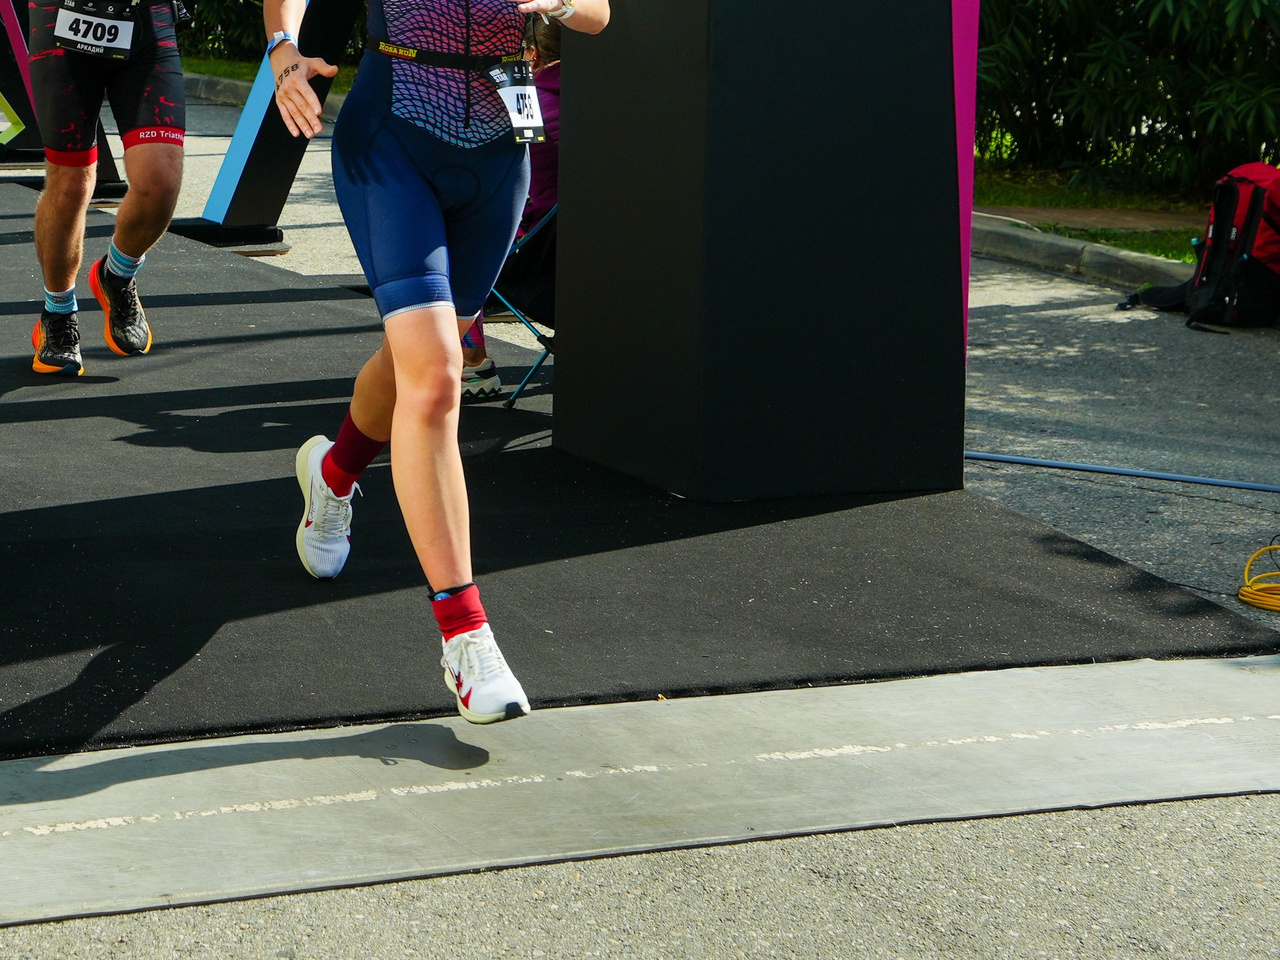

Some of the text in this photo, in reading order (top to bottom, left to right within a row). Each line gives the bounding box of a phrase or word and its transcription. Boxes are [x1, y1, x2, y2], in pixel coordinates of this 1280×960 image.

[68, 17, 119, 43] 4709
[76, 43, 104, 54] АРКАДИЙ
[139, 130, 157, 139] RZD
